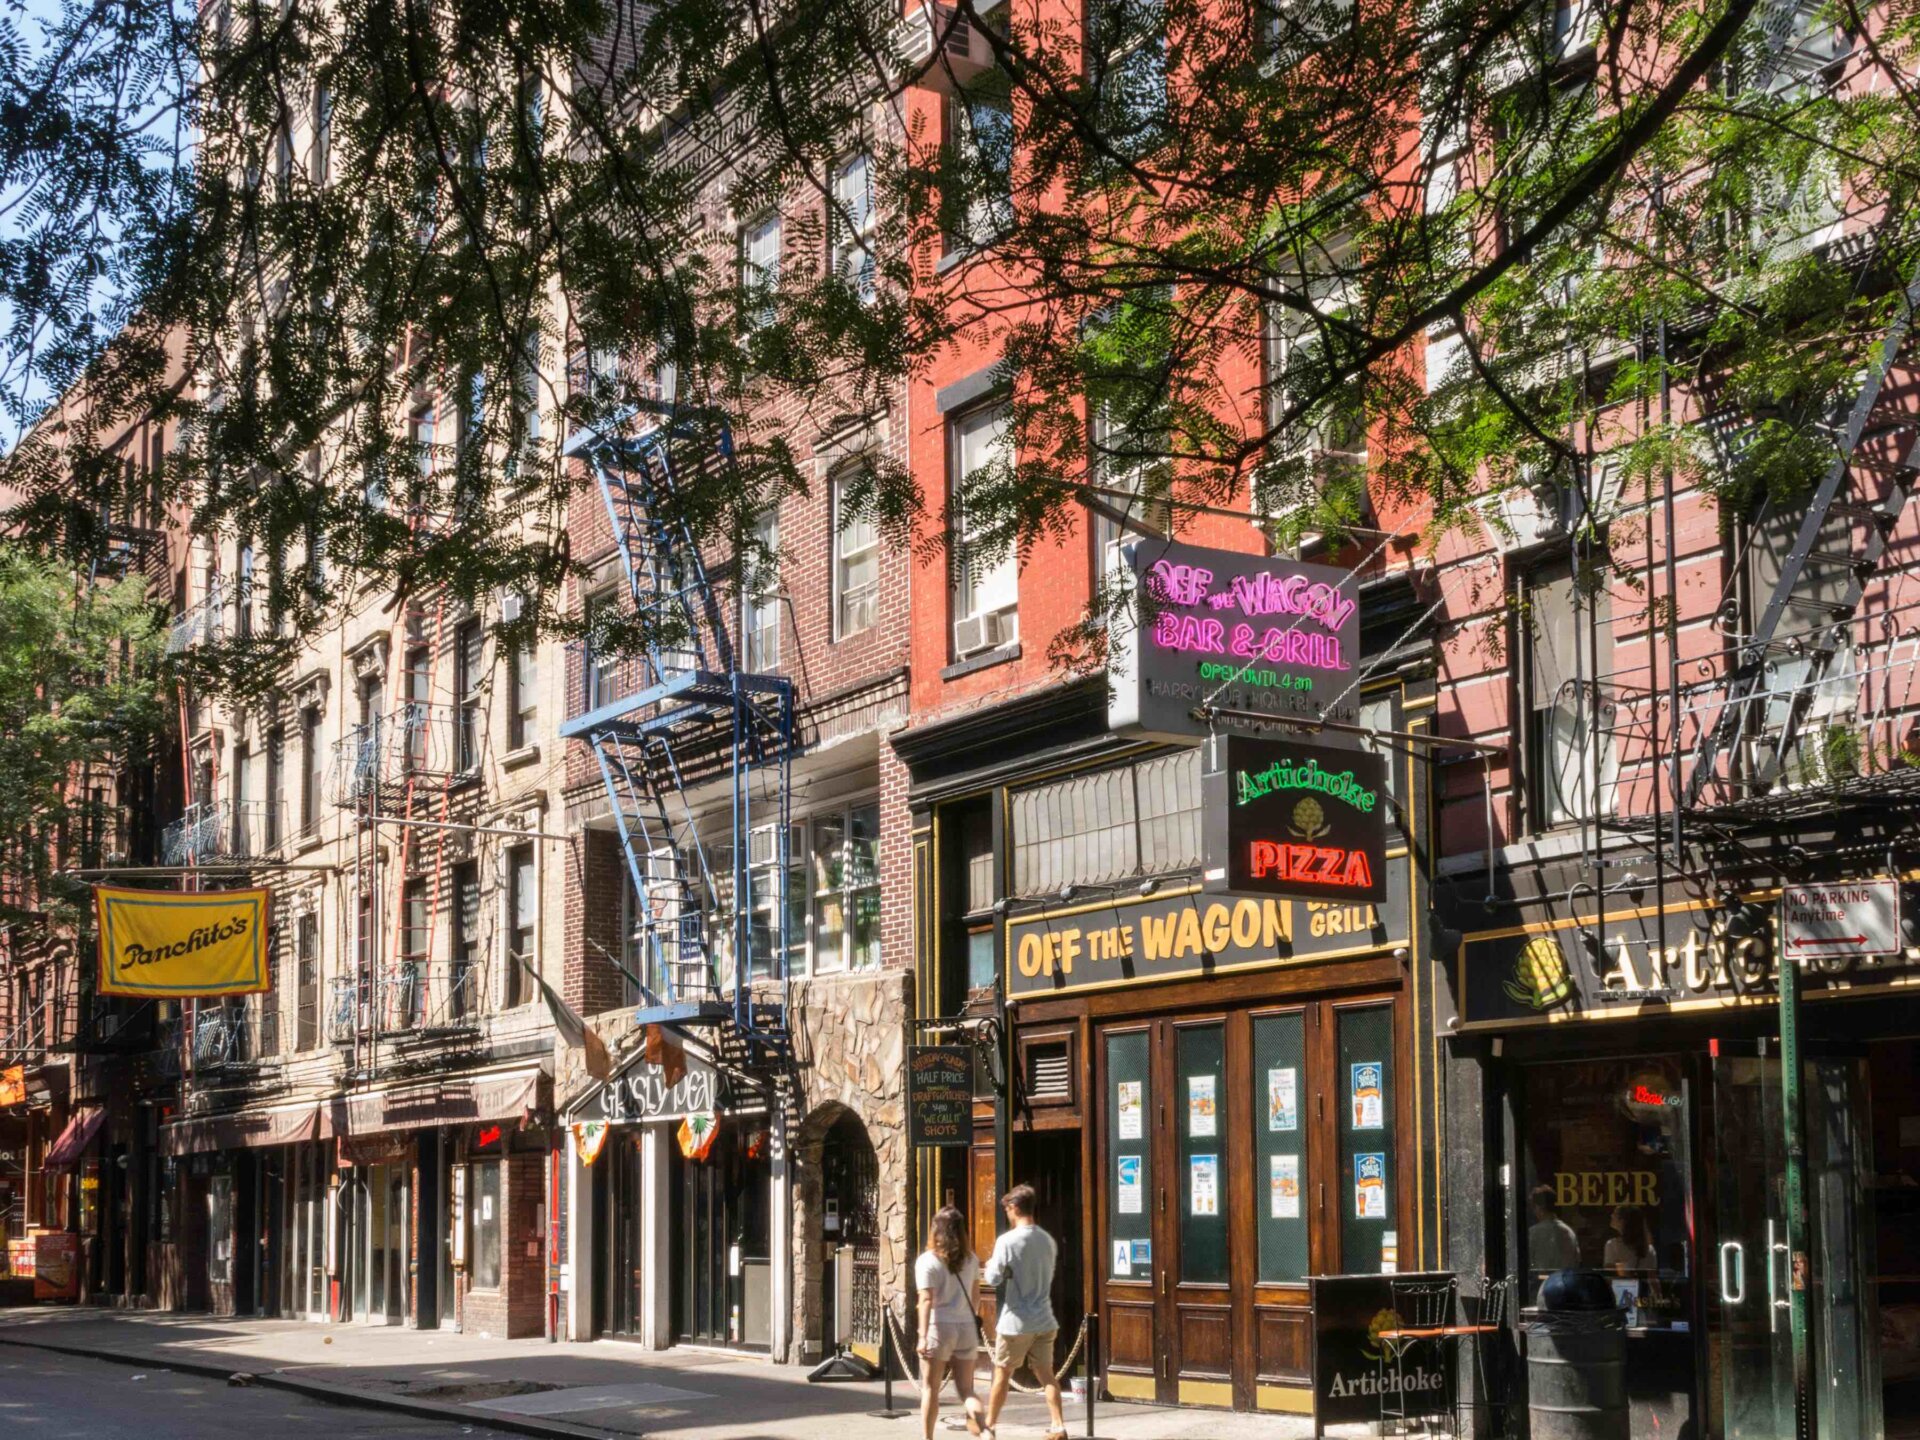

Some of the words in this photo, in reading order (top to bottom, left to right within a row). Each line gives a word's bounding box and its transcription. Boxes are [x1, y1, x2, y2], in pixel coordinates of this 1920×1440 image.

[1147, 560, 1212, 606] OFF
[1230, 571, 1355, 632] WAGON
[1156, 611, 1225, 655] BAR
[1230, 622, 1261, 659] &
[1263, 627, 1350, 671] GRILL
[1200, 662, 1238, 682] OPEN
[1242, 668, 1284, 689] UNTIL
[1236, 759, 1376, 812] Artichoke
[1250, 841, 1373, 887] PIZZA
[1789, 893, 1808, 906] NO
[1812, 889, 1870, 905] PARKING
[1791, 908, 1846, 924] Anytime
[120, 917, 248, 970] Panchito's
[1017, 928, 1082, 977] OFF
[1086, 925, 1134, 961] THE
[1140, 899, 1292, 960] WAGON
[1310, 904, 1376, 937] GRILL
[916, 1071, 939, 1085] HALF
[941, 1071, 965, 1083] PRICE
[925, 1124, 958, 1136] SHOTS
[1553, 1171, 1661, 1206] BEER
[1117, 1245, 1128, 1265] A
[1328, 1366, 1443, 1398] Artichoke
